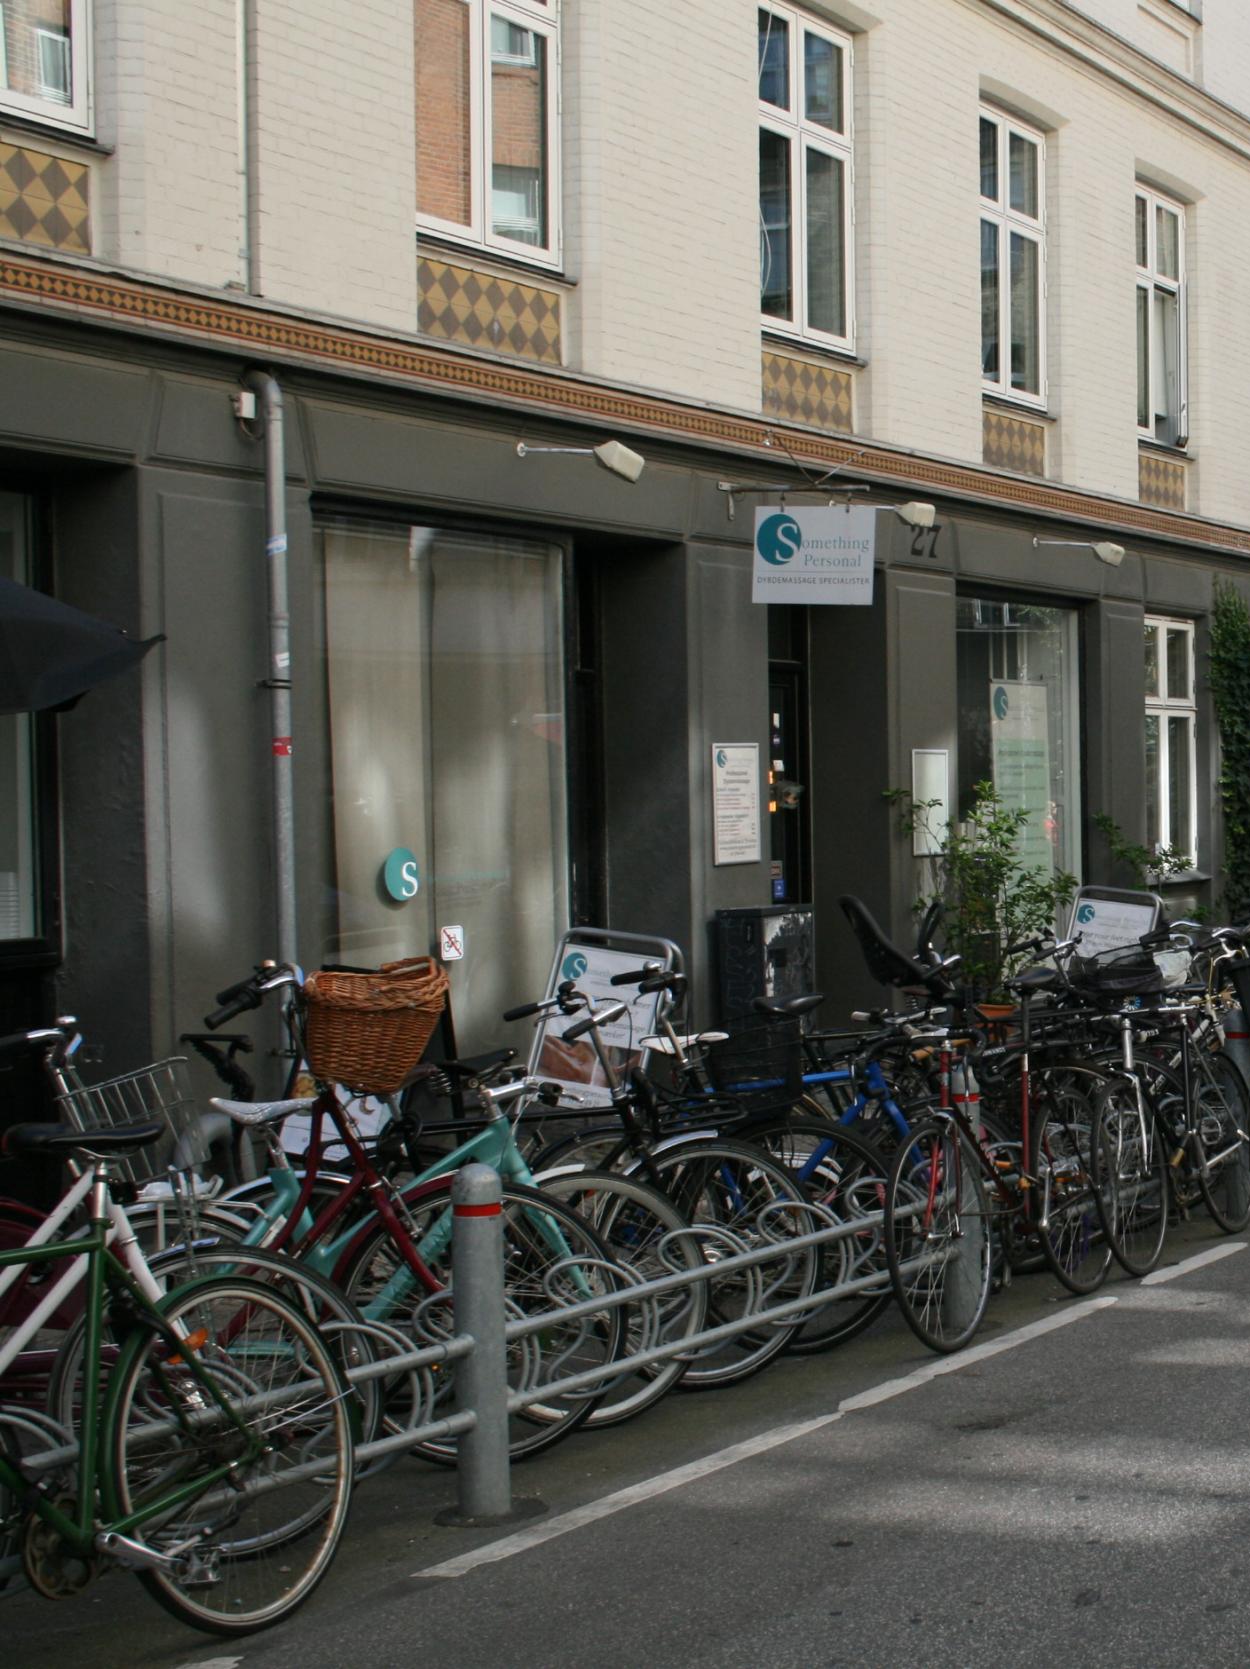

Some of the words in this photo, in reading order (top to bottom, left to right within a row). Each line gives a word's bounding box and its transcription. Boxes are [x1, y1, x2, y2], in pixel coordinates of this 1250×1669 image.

[775, 522, 870, 562] Something
[911, 524, 943, 558] 27
[804, 553, 861, 568] Personal
[757, 575, 816, 585] DYBDEMASSAGE
[818, 576, 870, 585] SPECIALISTER
[402, 861, 419, 897] S
